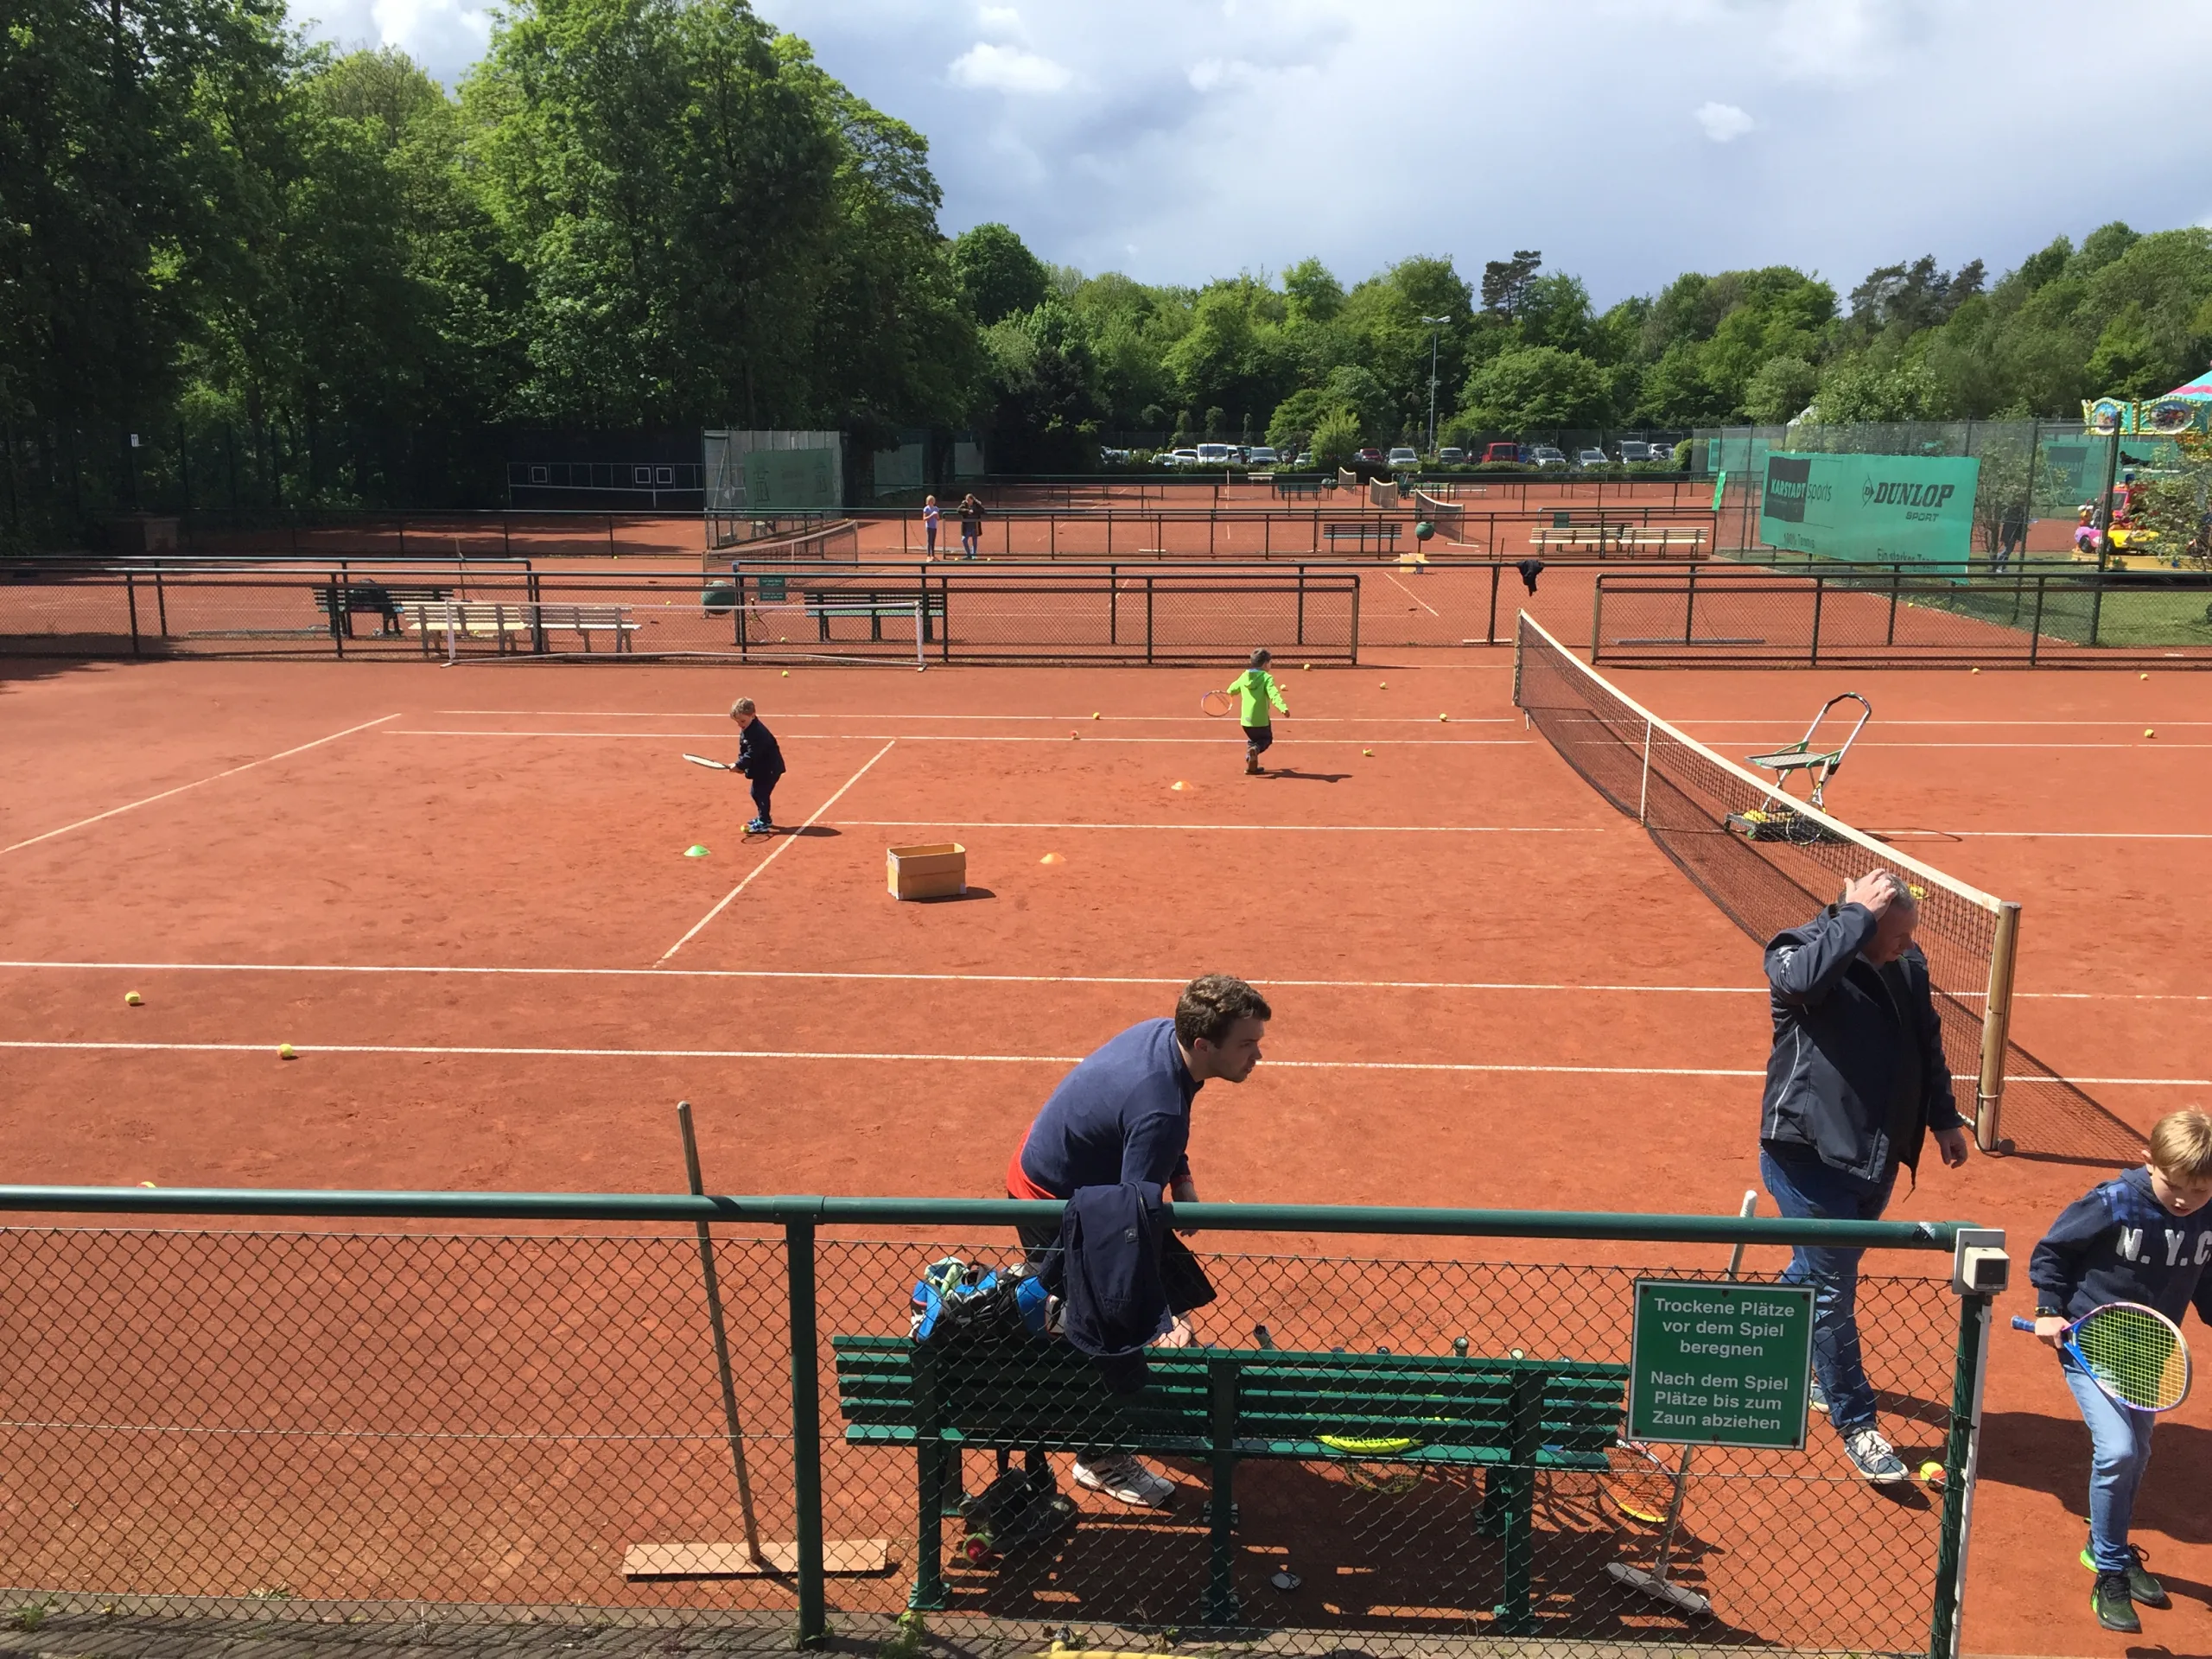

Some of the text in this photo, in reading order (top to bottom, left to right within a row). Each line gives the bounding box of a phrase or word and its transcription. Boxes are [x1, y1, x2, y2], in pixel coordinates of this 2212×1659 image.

[1770, 479, 1832, 504] KARSTADT sports
[1873, 482, 1955, 508] DUNLOP
[1905, 512, 1940, 522] SPORT
[1877, 548, 1888, 562] Ein
[1654, 1298, 1795, 1317] Trockene Plätze
[1662, 1320, 1784, 1339] vor dem Spiel
[1680, 1340, 1764, 1357] beregnen
[1650, 1371, 1789, 1392] Nach dem Spiel
[1654, 1391, 1782, 1410] Plätze bis zum
[1652, 1410, 1781, 1430] Zaun abziehen
